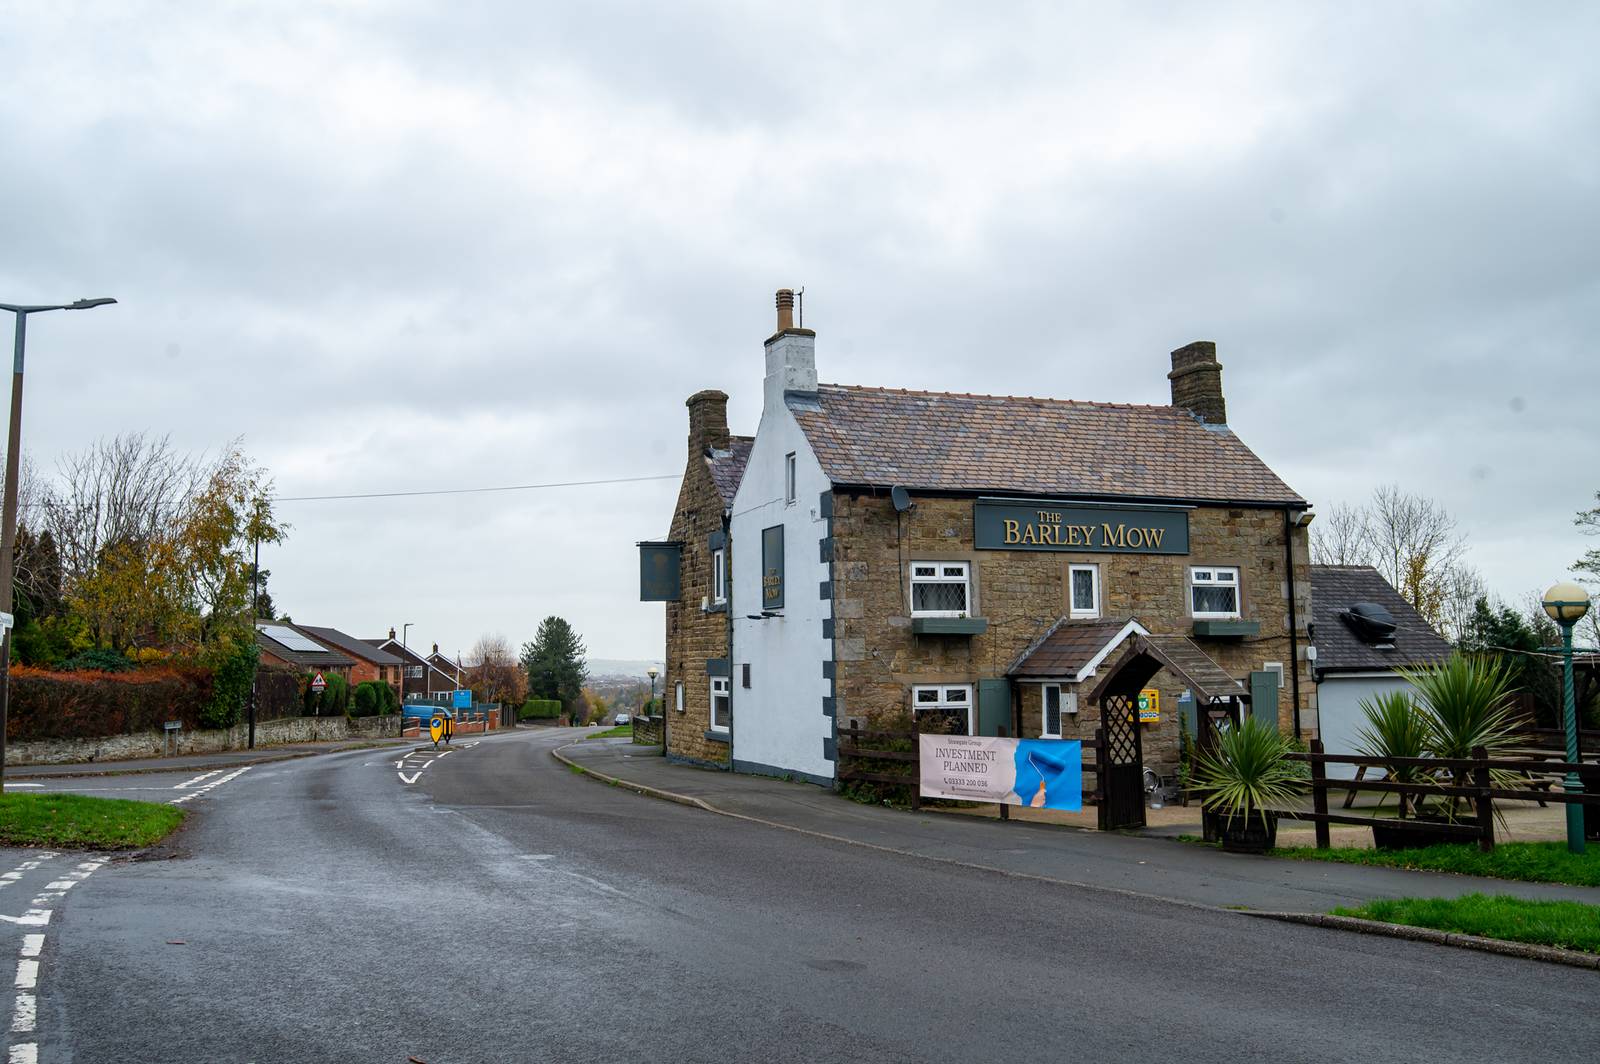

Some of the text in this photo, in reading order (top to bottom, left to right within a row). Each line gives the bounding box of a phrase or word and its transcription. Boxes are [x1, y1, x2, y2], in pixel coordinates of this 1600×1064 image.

[1037, 511, 1062, 523] THE
[1003, 519, 1166, 549] BARLEY MOW
[935, 747, 997, 761] INVESTMENT
[943, 760, 988, 774] PLANNED
[948, 777, 965, 786] 03333
[966, 779, 977, 787] 200
